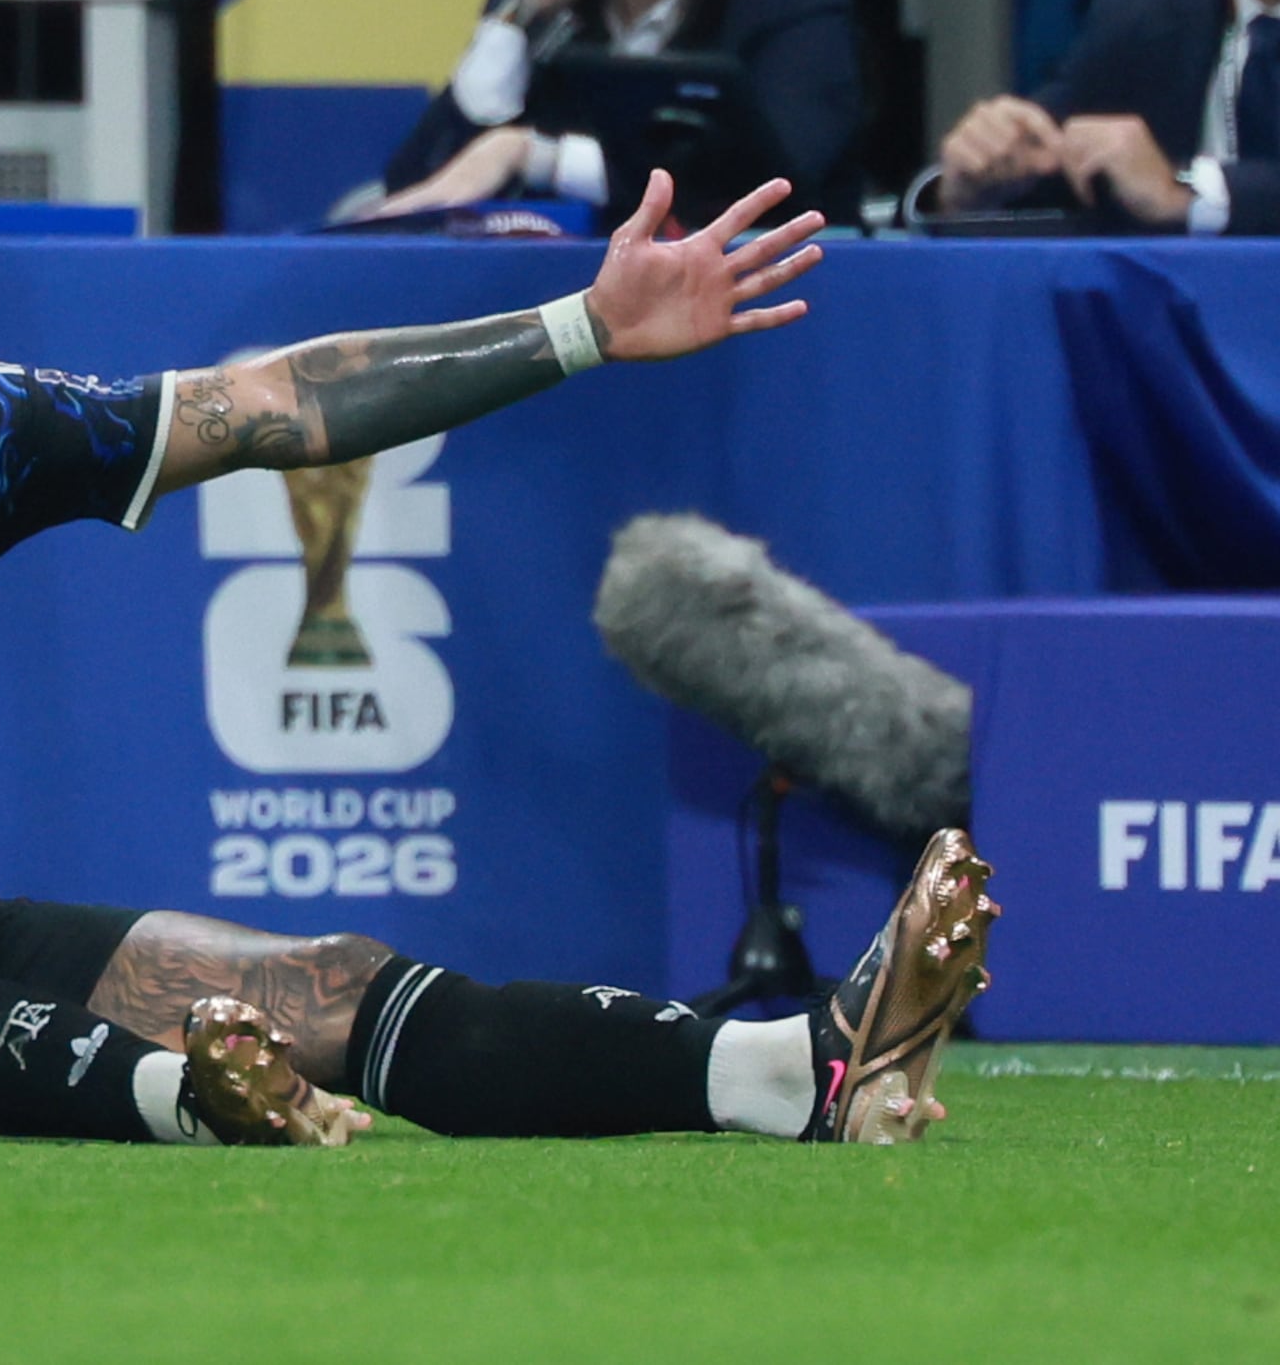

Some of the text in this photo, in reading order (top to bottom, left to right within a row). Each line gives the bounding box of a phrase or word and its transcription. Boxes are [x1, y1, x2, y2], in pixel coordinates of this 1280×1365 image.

[279, 691, 390, 733] FIFA
[209, 787, 456, 829] WORLD CUP
[209, 834, 458, 897] 2026
